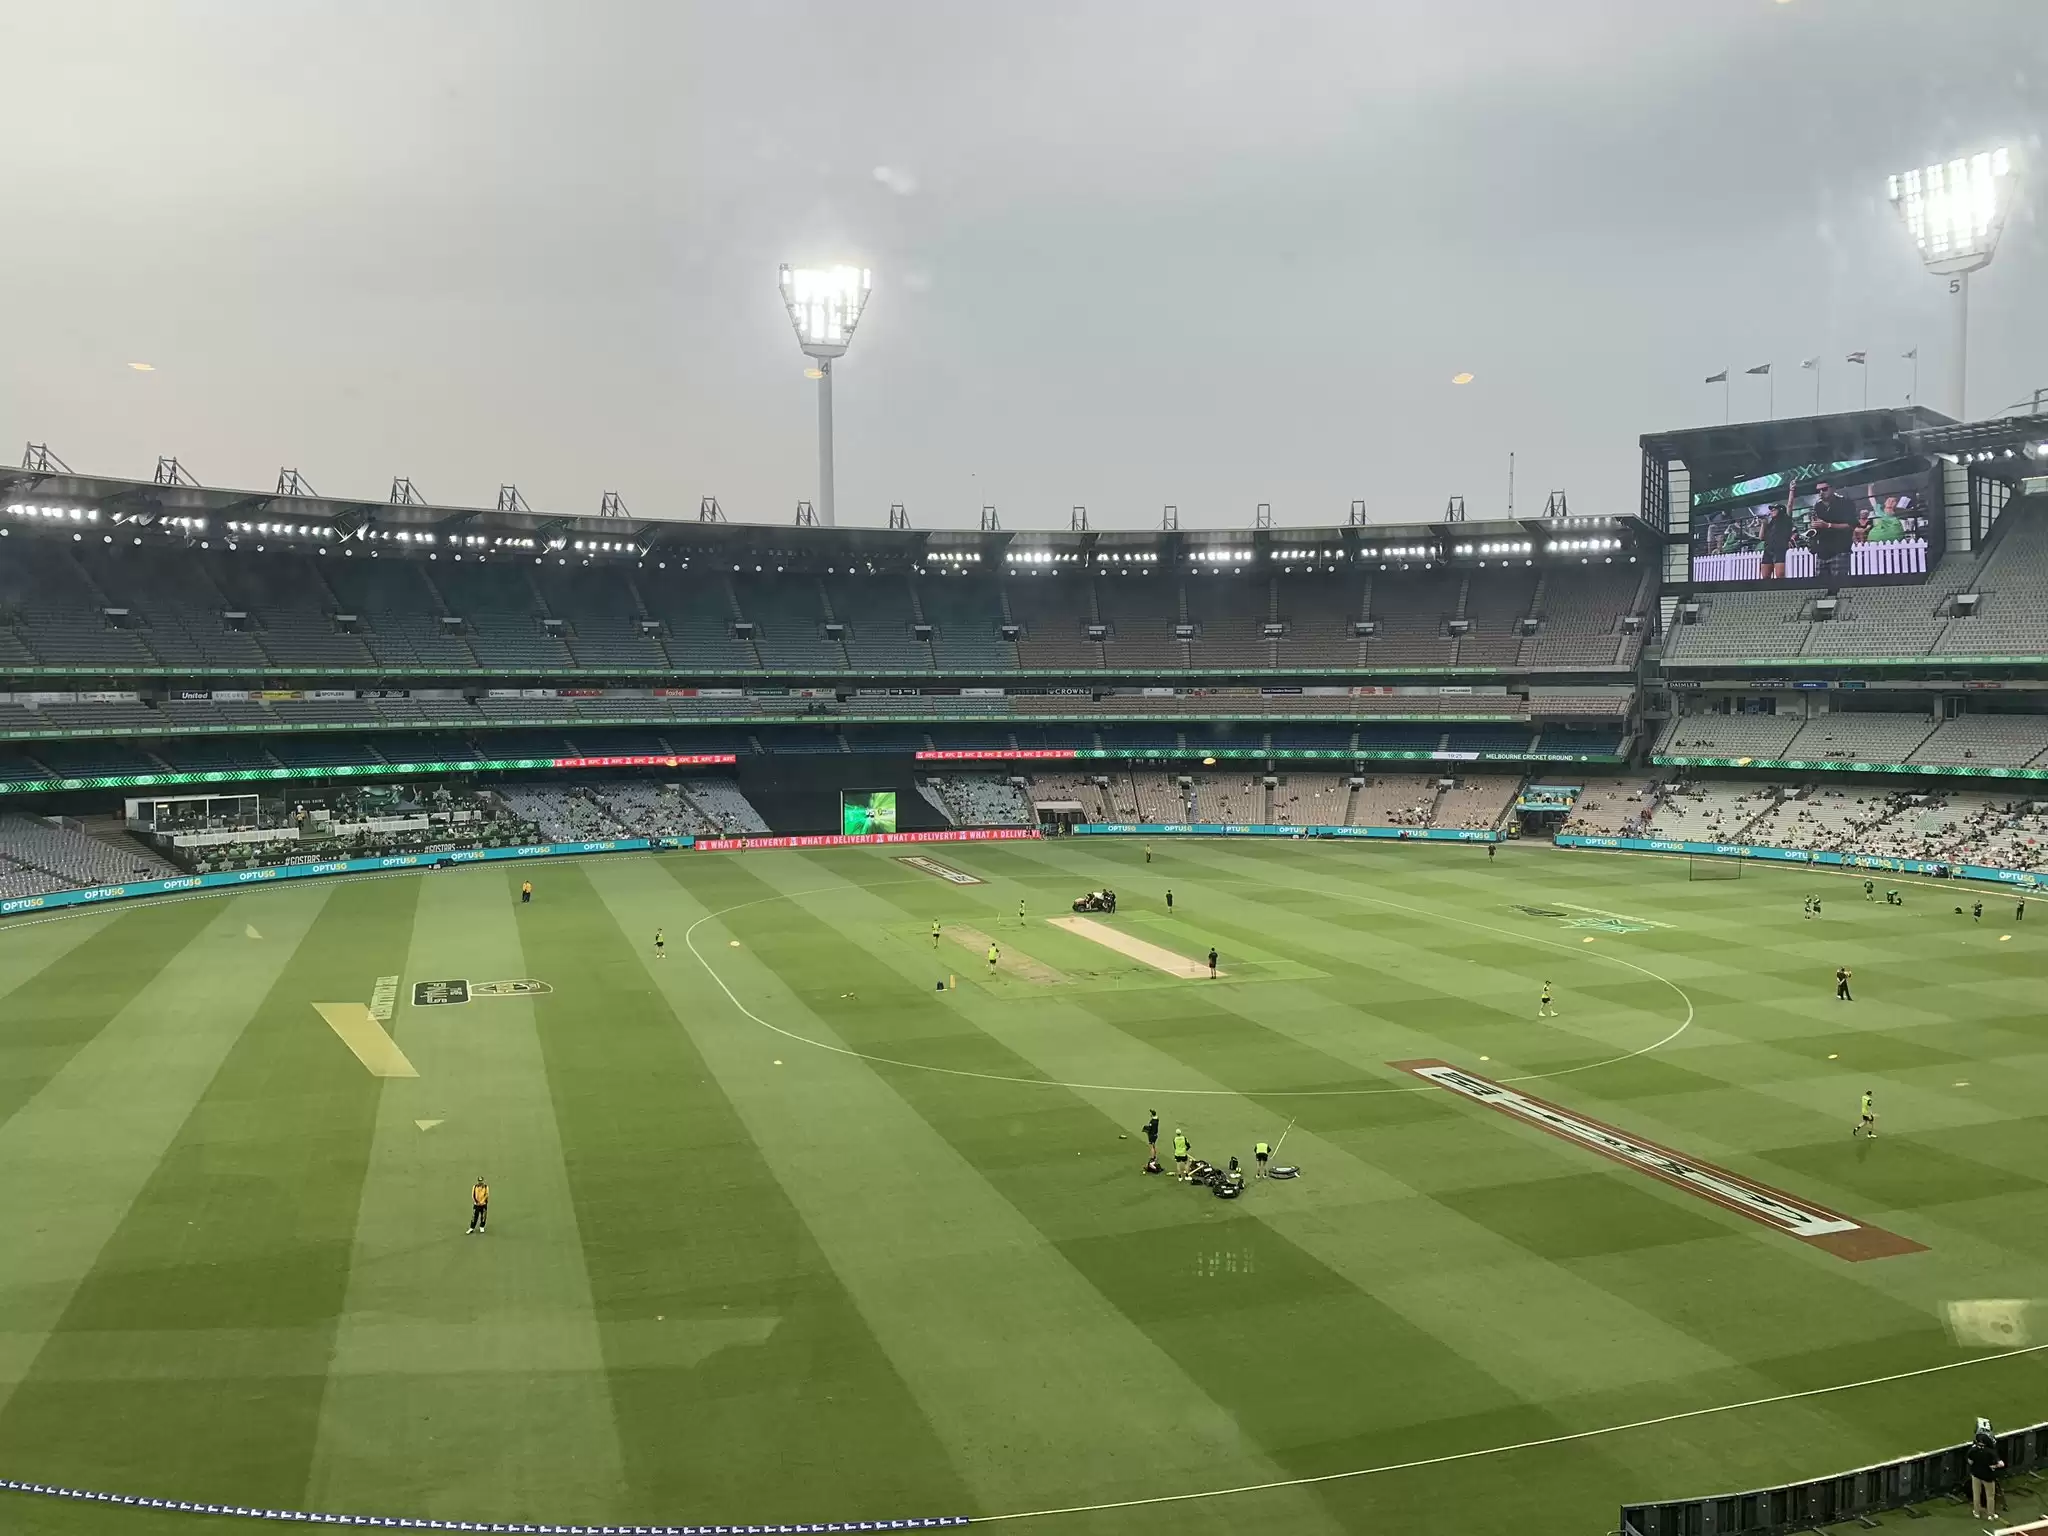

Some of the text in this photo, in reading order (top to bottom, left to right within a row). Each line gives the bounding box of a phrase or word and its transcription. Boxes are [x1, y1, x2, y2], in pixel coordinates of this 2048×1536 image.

[1950, 280, 1960, 293] 5
[821, 362, 830, 375] 4
[801, 834, 873, 844] WHAT A DELIVERY!
[888, 834, 907, 842] WHAT
[918, 832, 957, 840] DELIVERY!
[970, 831, 990, 839] WHAT
[711, 840, 732, 848] WHAT
[745, 838, 786, 848] DELIVERY!
